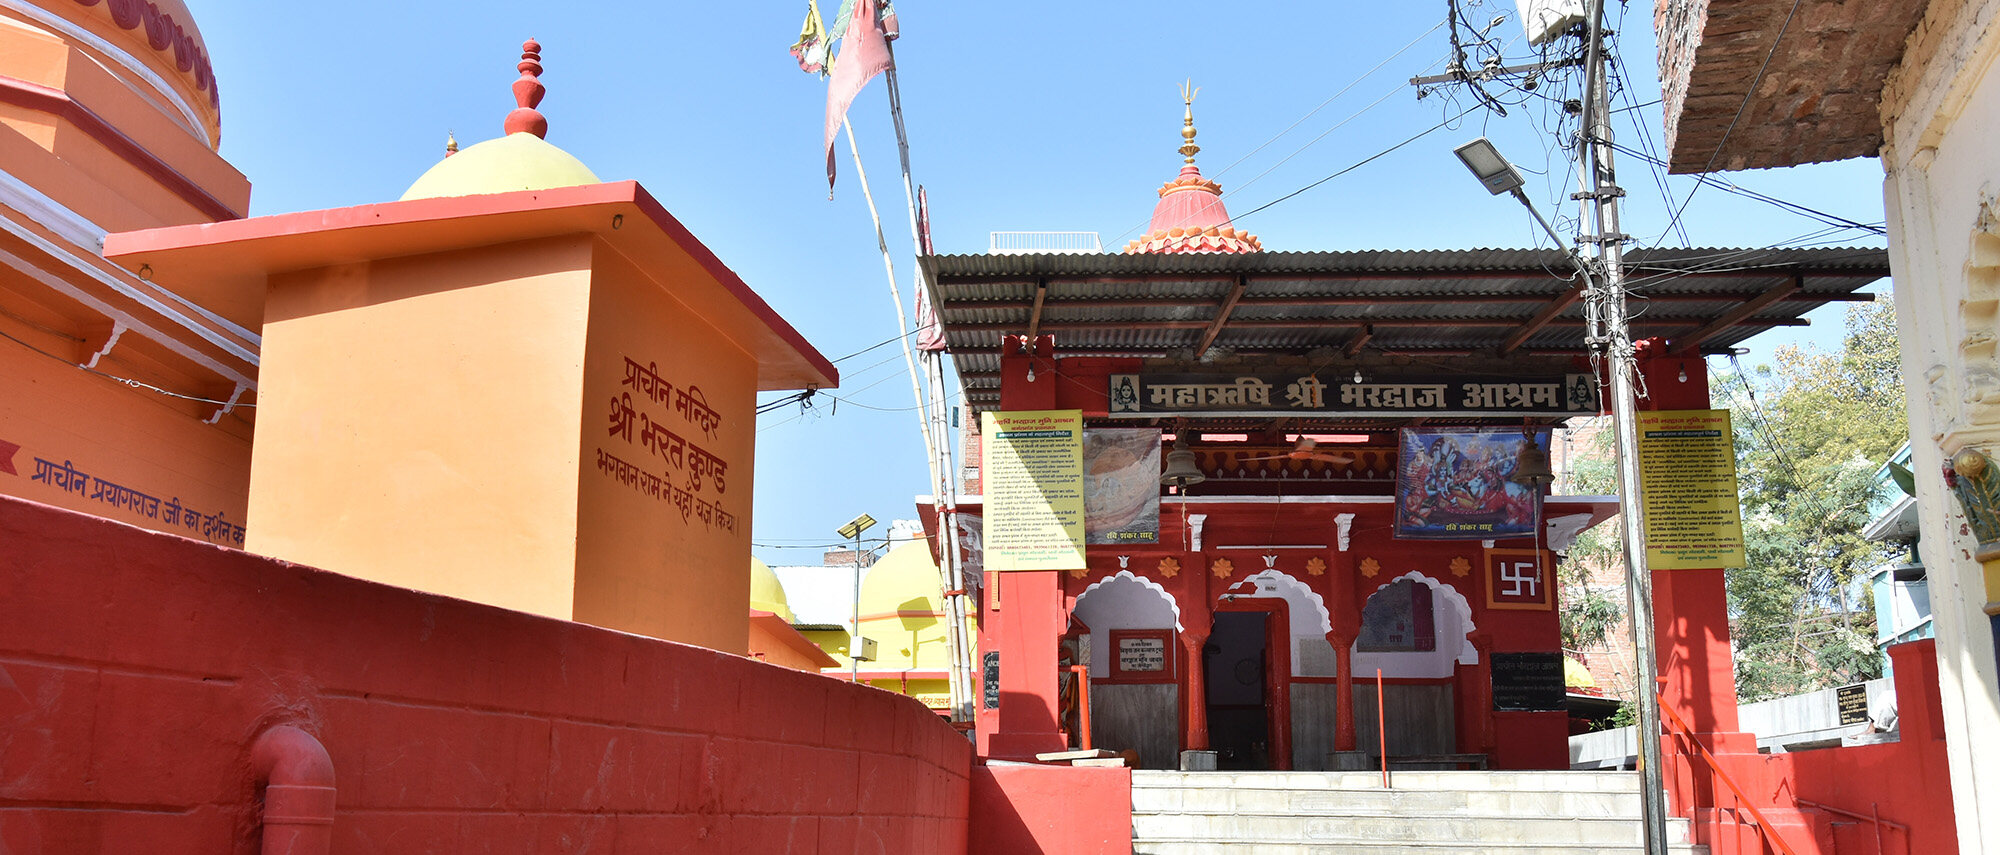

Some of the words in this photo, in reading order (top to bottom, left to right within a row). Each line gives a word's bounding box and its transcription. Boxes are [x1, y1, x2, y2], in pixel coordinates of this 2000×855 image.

[622, 356, 672, 410] प्राचीन
[675, 385, 721, 441] मन्दिर
[1147, 376, 1272, 406] महाऋषि
[1284, 376, 1328, 408] श्री
[1341, 383, 1449, 409] भरद्वाज
[1462, 382, 1561, 408] आश्रम
[608, 392, 636, 444] श्री
[640, 412, 686, 470] भरत
[688, 442, 728, 494] कुण्ड
[31, 456, 90, 498] प्राचीन
[91, 477, 161, 519] प्रयागराज
[162, 497, 182, 526] जी
[184, 508, 201, 532] का
[203, 511, 232, 544] दर्शन
[597, 448, 640, 491] भगवान
[640, 466, 662, 501] राम
[663, 471, 672, 504] ने
[674, 480, 694, 526] यहाँ
[696, 498, 713, 533] यज्ञ
